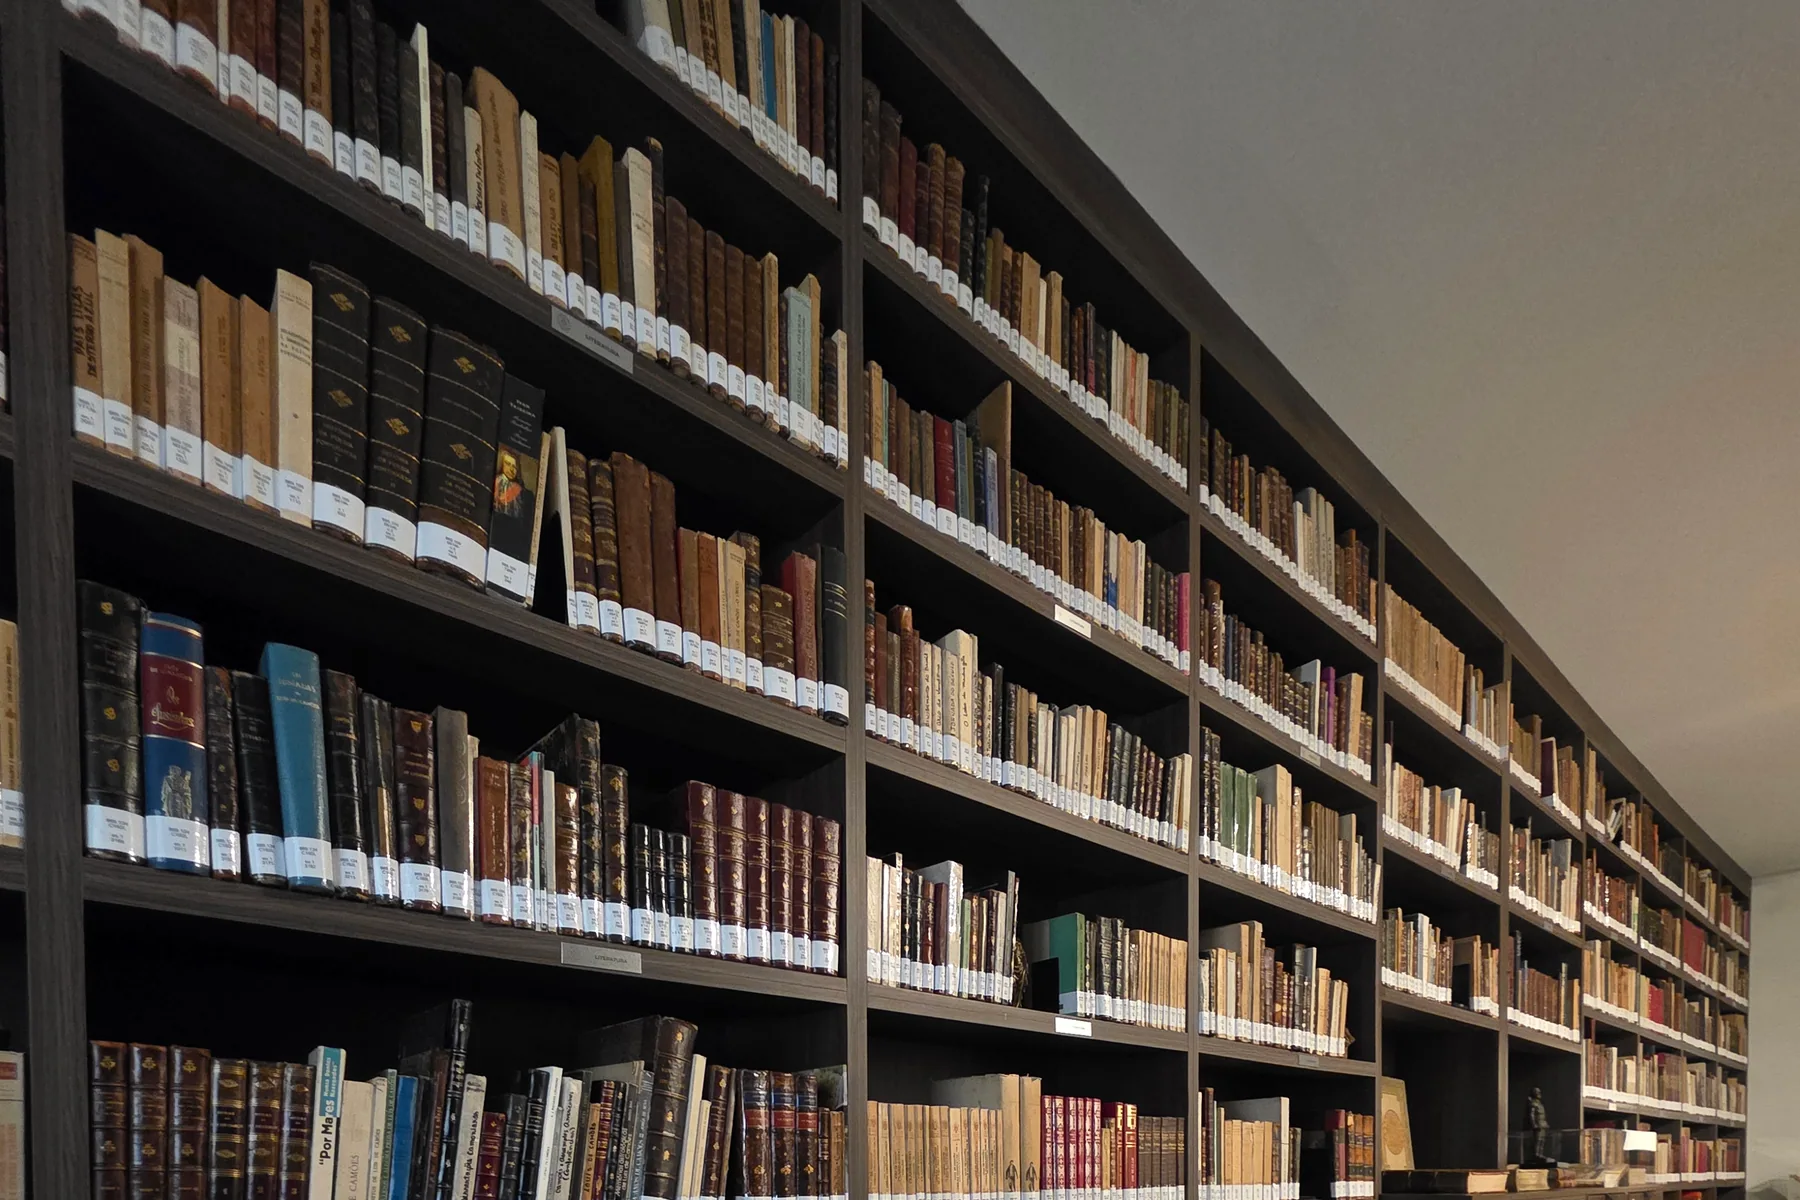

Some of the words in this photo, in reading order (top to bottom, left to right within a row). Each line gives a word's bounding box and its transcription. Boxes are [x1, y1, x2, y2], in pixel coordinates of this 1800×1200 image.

[585, 334, 620, 357] LITERATURA
[595, 955, 628, 963] LITERATURA
[321, 1100, 334, 1134] Mares
[348, 1154, 359, 1192] CAMÕES
